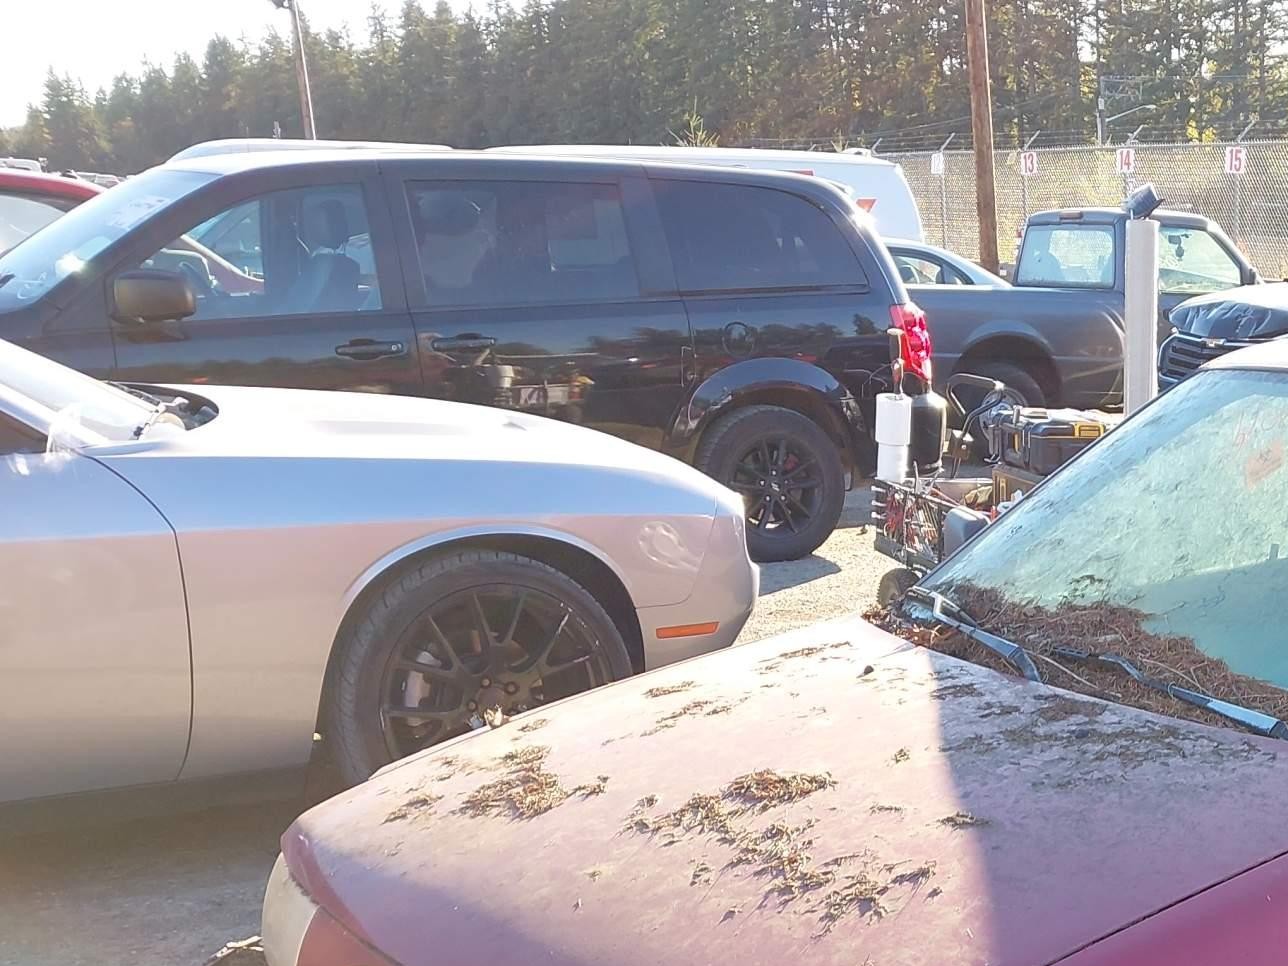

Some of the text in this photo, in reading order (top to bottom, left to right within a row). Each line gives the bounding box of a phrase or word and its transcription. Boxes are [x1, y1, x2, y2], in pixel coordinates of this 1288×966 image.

[1023, 153, 1035, 174] 13
[1119, 149, 1132, 171] 14
[1230, 148, 1243, 172] 15
